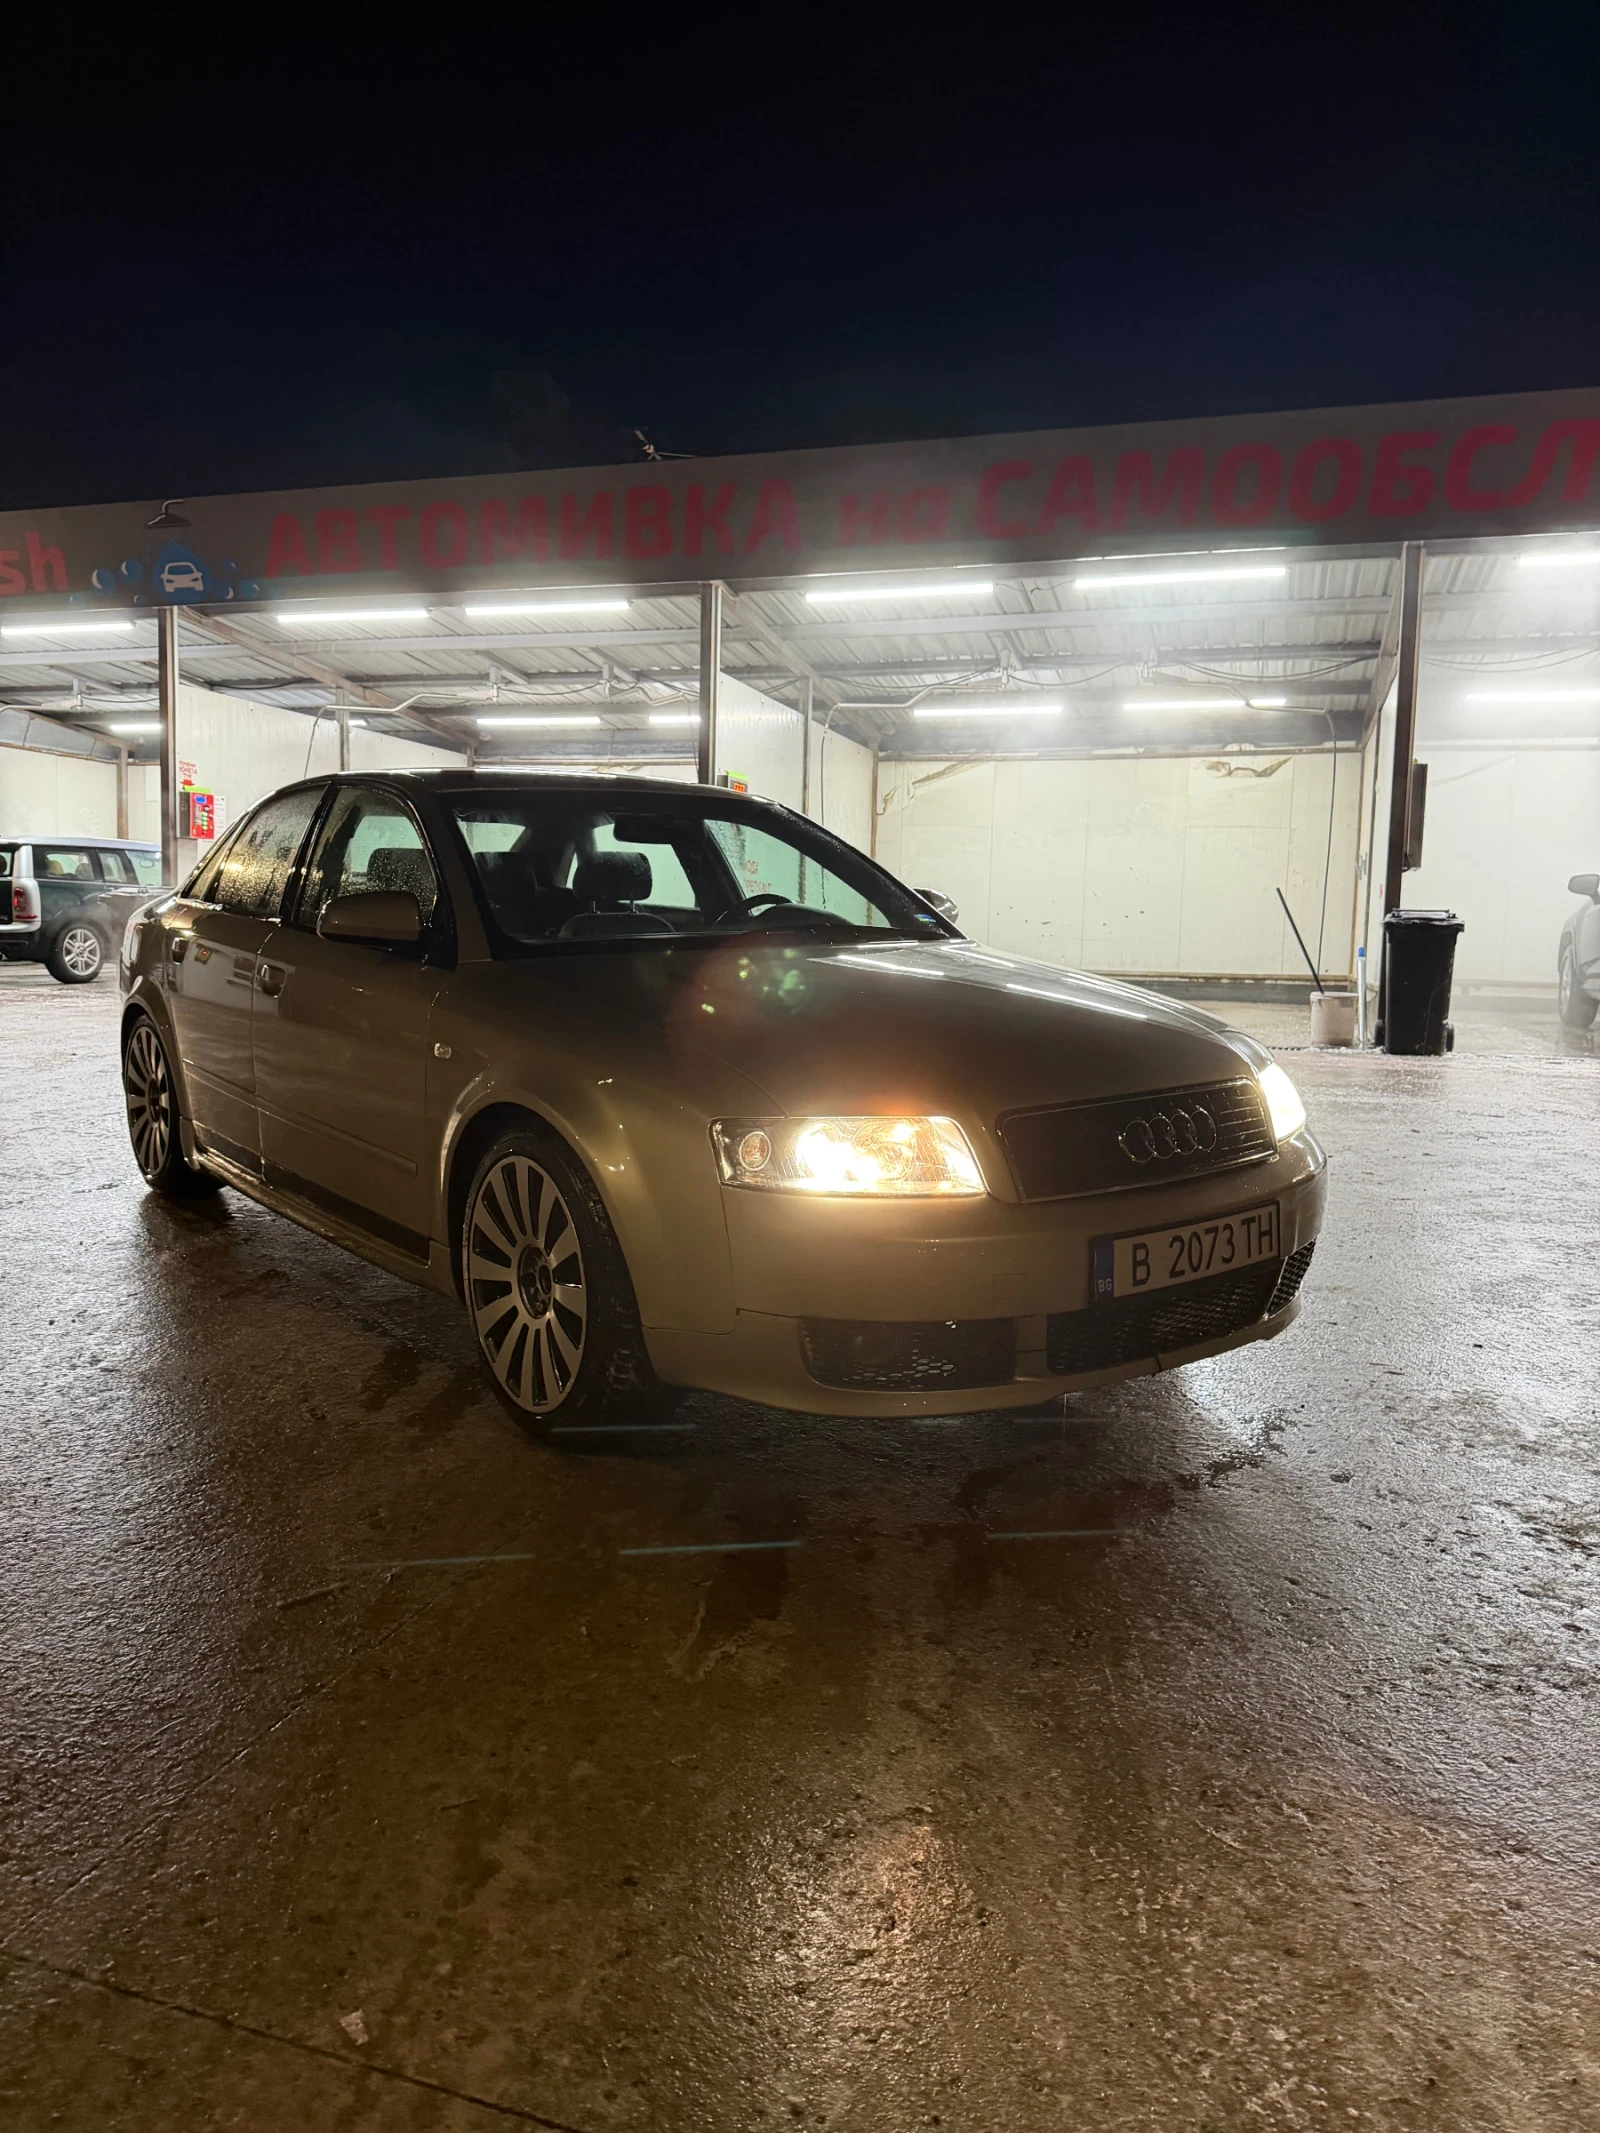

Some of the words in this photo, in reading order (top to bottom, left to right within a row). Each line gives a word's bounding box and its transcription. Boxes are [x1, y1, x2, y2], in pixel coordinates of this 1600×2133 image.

[265, 478, 805, 578] АВТОМИВКА
[840, 485, 949, 547] на
[977, 418, 1600, 540] САМООБСЛ
[1098, 1277, 1112, 1292] BG
[1132, 1242, 1150, 1287] B
[1169, 1223, 1236, 1278] 2073
[1241, 1211, 1273, 1259] TH
